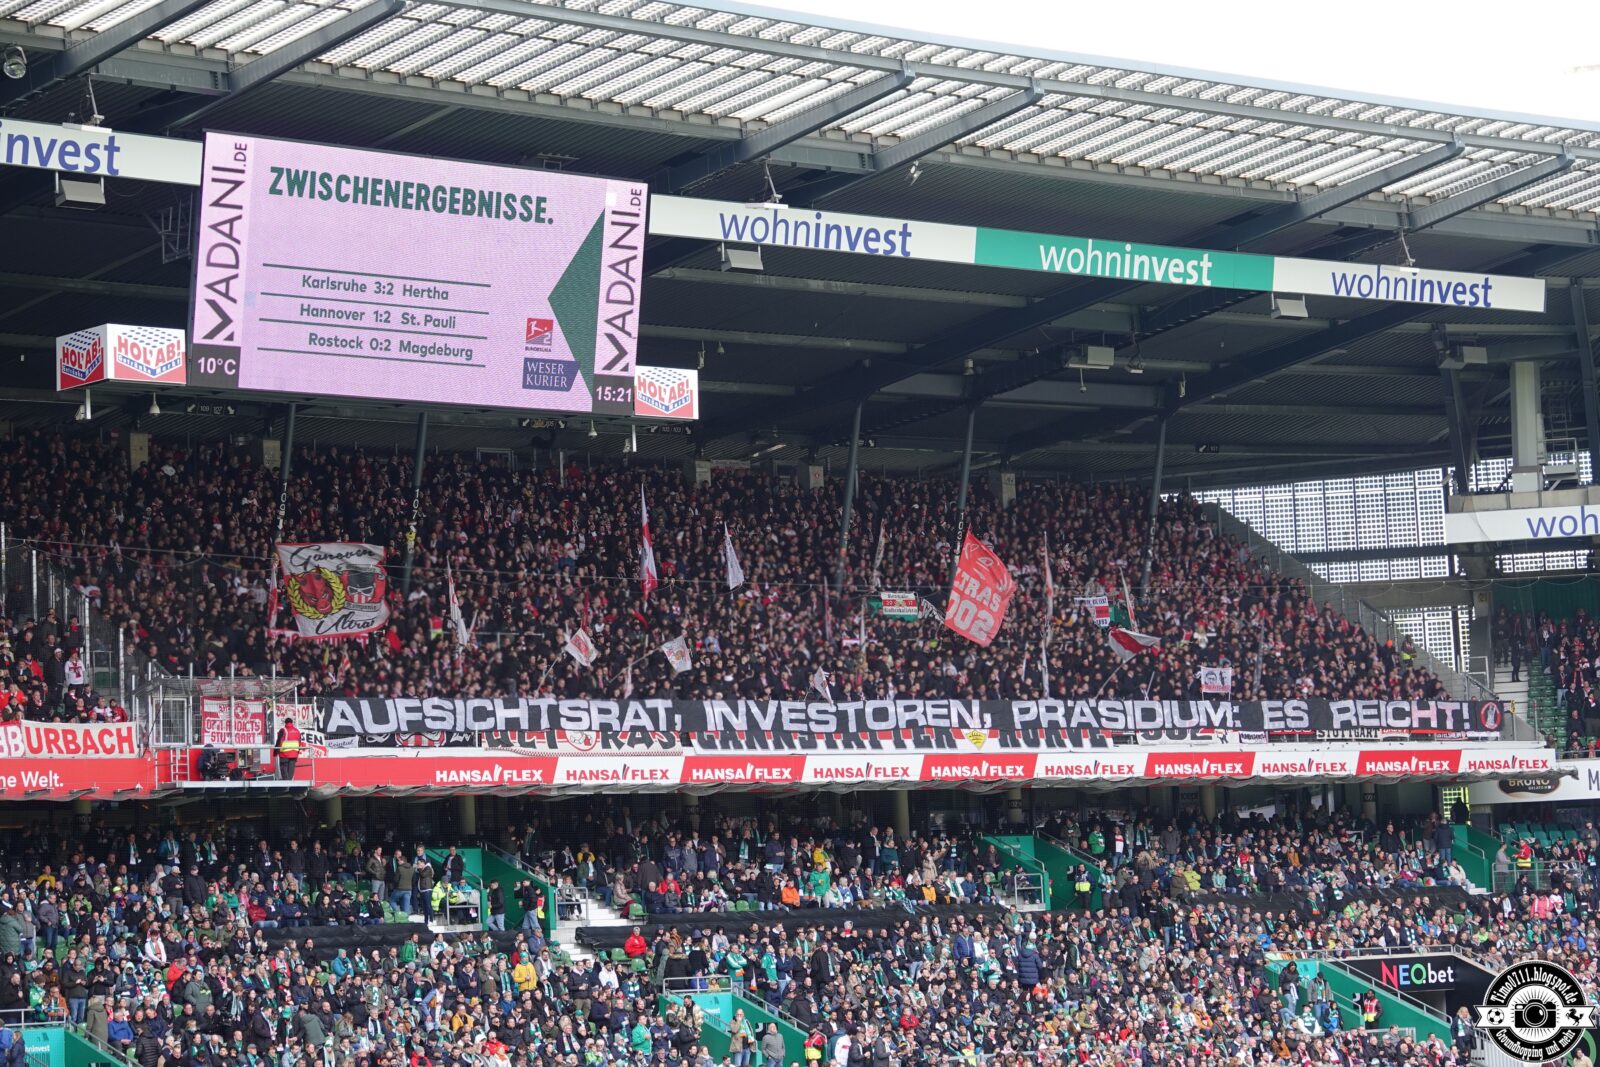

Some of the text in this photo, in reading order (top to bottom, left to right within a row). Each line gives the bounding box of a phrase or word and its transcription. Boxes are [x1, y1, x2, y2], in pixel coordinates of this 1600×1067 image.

[269, 166, 554, 225] ZWISCHENERGEBNISSE.
[719, 209, 912, 257] wohninvest
[1040, 238, 1213, 286] wohninvest
[301, 275, 449, 300] Karlsruhe 3:2 Hertha
[1332, 264, 1493, 308] wohninvest
[300, 304, 456, 329] Hannover 1:2 St. Pauli
[117, 335, 181, 367] HOL'AB!
[308, 332, 473, 361] Rostock 0:2 Magdeburg
[197, 356, 236, 376] 10°C
[526, 361, 564, 375] WESER
[526, 373, 568, 388] KURIER
[637, 375, 689, 401] HOL'AB!
[596, 386, 632, 403] 15:21
[326, 697, 682, 734] AUFSICHTSRAT,
[702, 699, 992, 732] INVESTOREN,
[1011, 699, 1241, 730] PRÄSIDIUM:
[1261, 699, 1309, 730] ES
[1329, 699, 1470, 730] REICHT!
[25, 726, 135, 755] URBACH
[692, 768, 792, 780] HANSA FLEX
[813, 767, 910, 778] HANSA FLEX
[931, 766, 1024, 777] HANSA FLEX
[1045, 764, 1134, 776] HANSA FLEX
[1154, 763, 1244, 774] HANSA FLEX
[1262, 762, 1348, 772] HANSA FLEX
[1366, 760, 1450, 772] HANSA FLEX
[1468, 760, 1548, 770] HANSA FLEX
[21, 770, 64, 788] Welt.
[436, 769, 543, 782] HANSA FLEX
[566, 769, 669, 780] HANSA FLEX
[1381, 960, 1454, 989] NEO.bet
